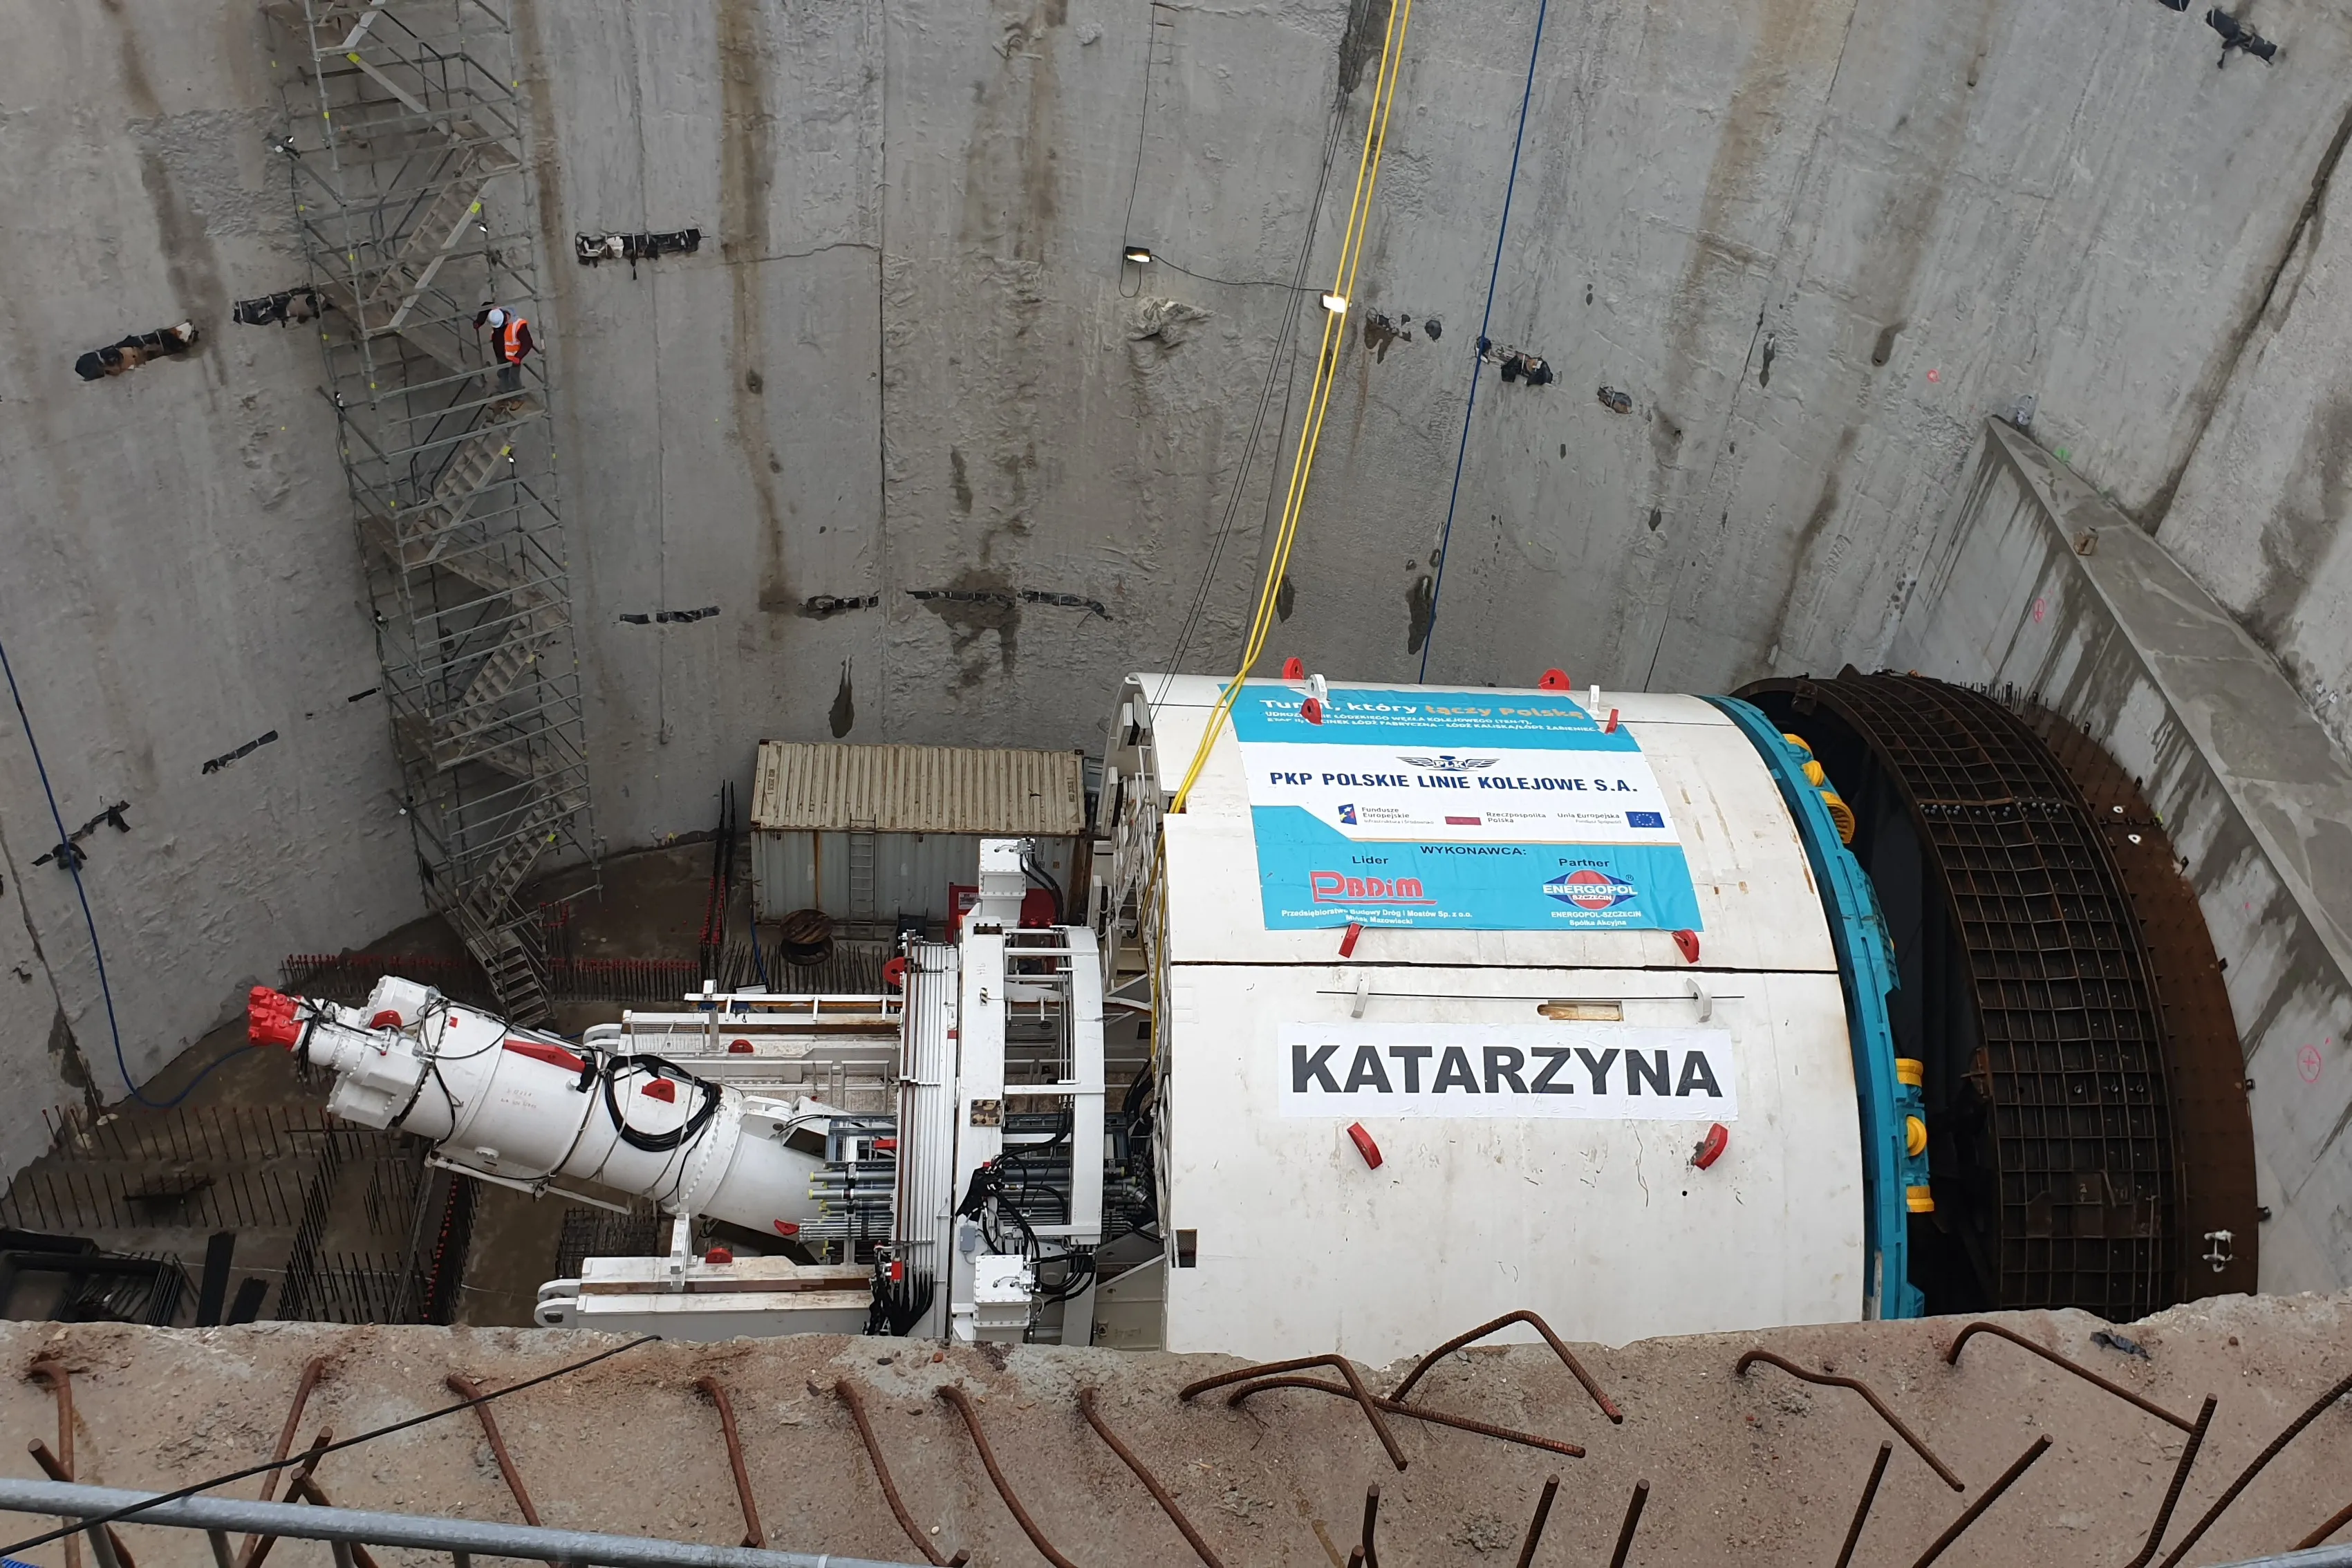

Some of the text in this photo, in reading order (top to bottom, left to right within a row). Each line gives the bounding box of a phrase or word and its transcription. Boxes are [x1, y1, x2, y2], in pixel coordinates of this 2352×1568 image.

[1259, 700, 1341, 711] Tunl,
[1346, 702, 1417, 714] który
[1433, 760, 1466, 768] PLK
[1270, 772, 1638, 792] PKP POLSKIE LINIE KOLEJOWE S.A.
[1419, 846, 1527, 856] WYKONAWCA:
[1352, 855, 1389, 864] Lider
[1558, 858, 1610, 868] Partner
[1542, 884, 1638, 895] ENERGOPOL
[1382, 909, 1401, 917] Dróg
[1437, 911, 1451, 919] Sp.
[1370, 916, 1413, 924] Mazowiecki
[1291, 1045, 1723, 1098] KATARZYNA
